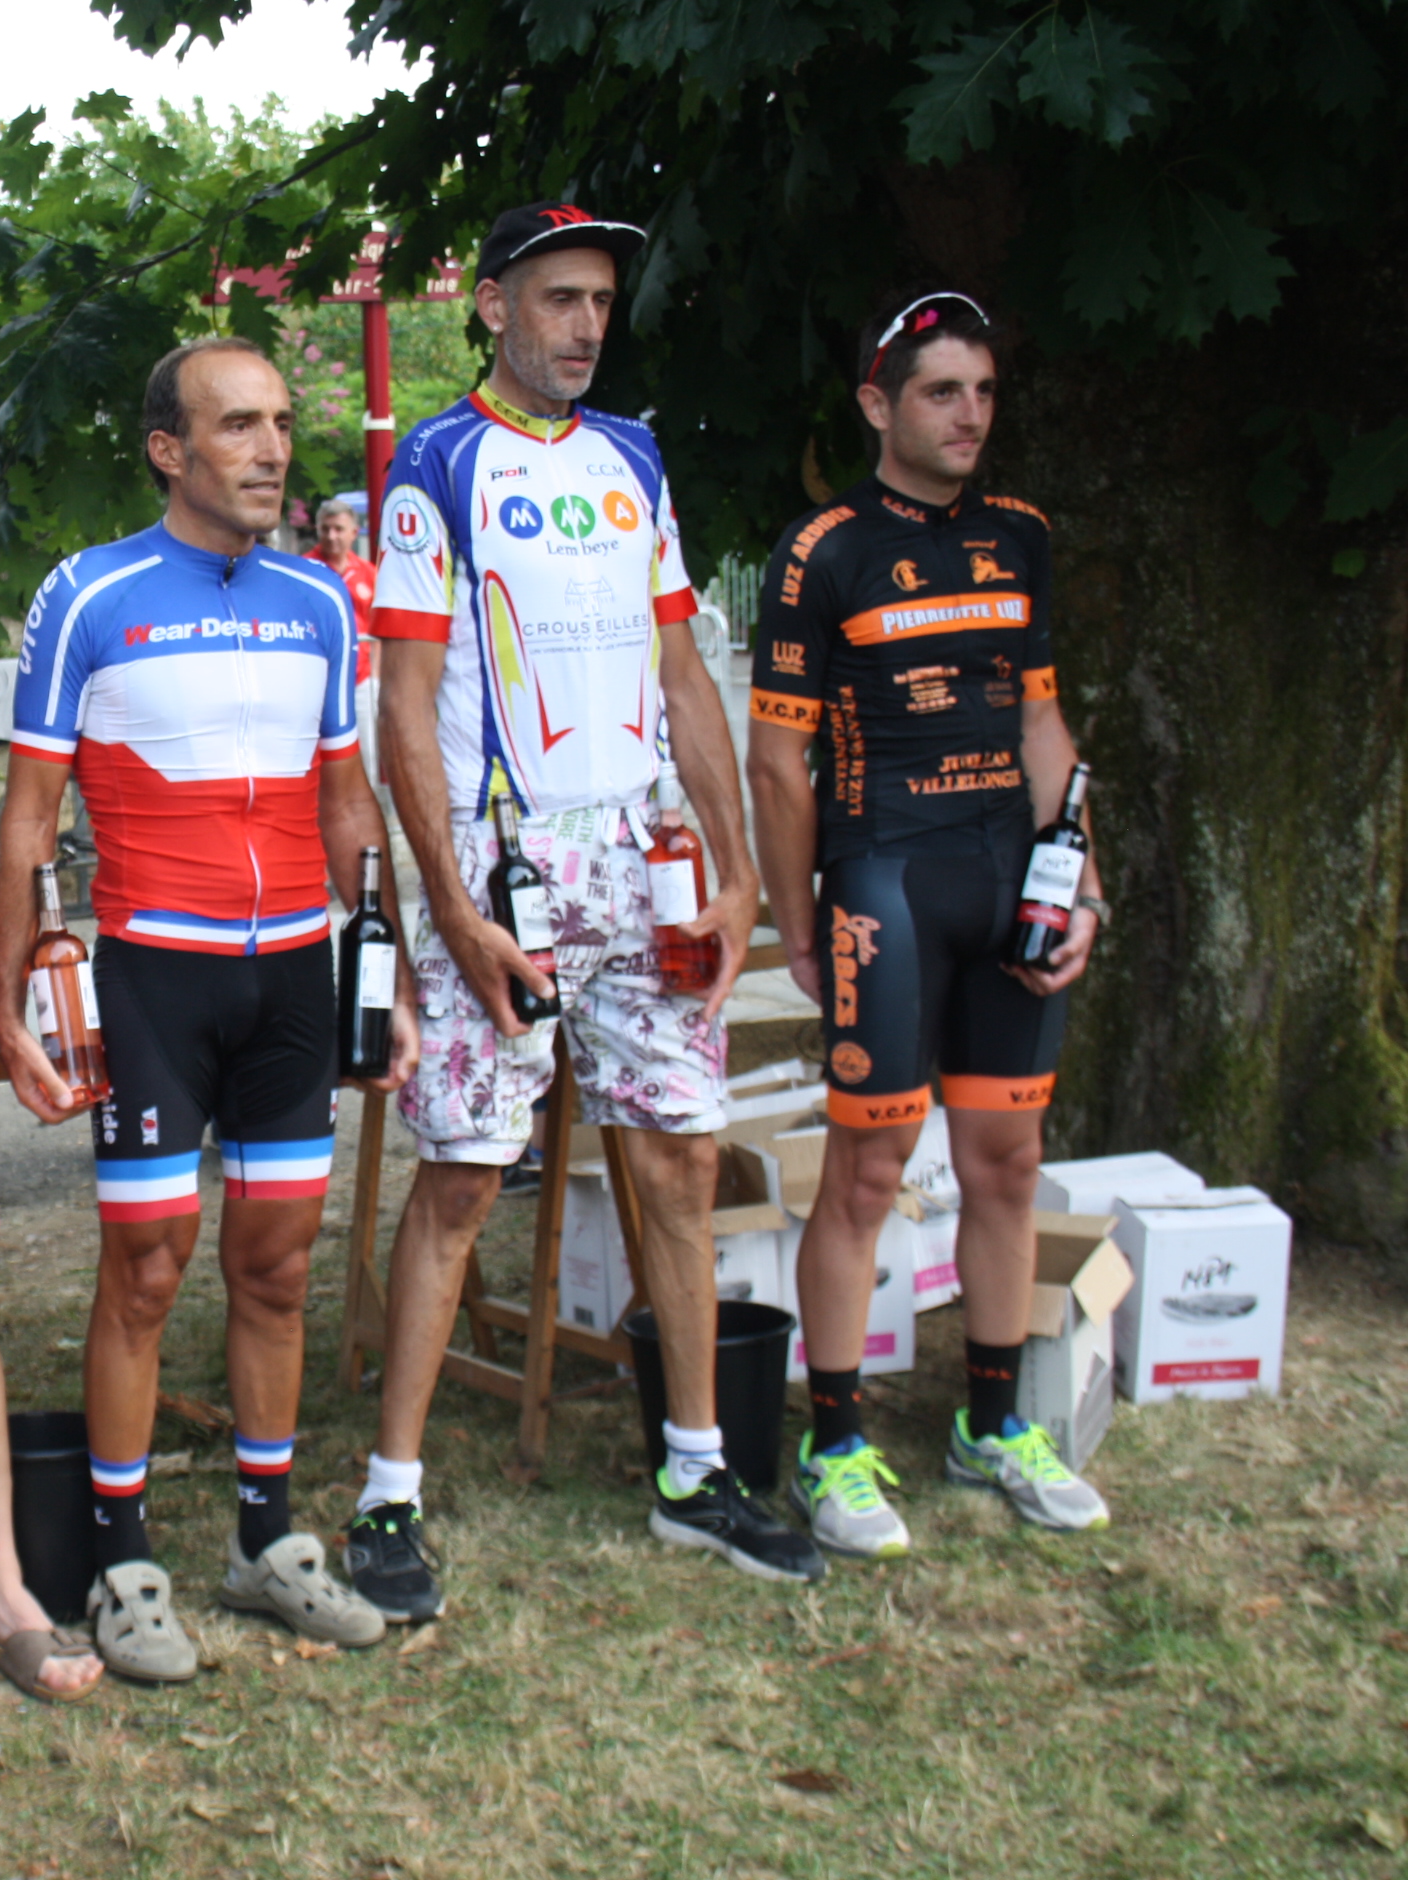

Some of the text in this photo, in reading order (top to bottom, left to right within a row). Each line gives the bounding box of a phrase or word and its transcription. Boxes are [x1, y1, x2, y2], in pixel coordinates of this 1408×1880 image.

[491, 465, 528, 482] poli
[781, 505, 857, 607] LUZ ARDIDEN
[996, 599, 1025, 622] LUZ
[522, 613, 648, 637] CROUSEILLES
[773, 640, 806, 667] LUZ
